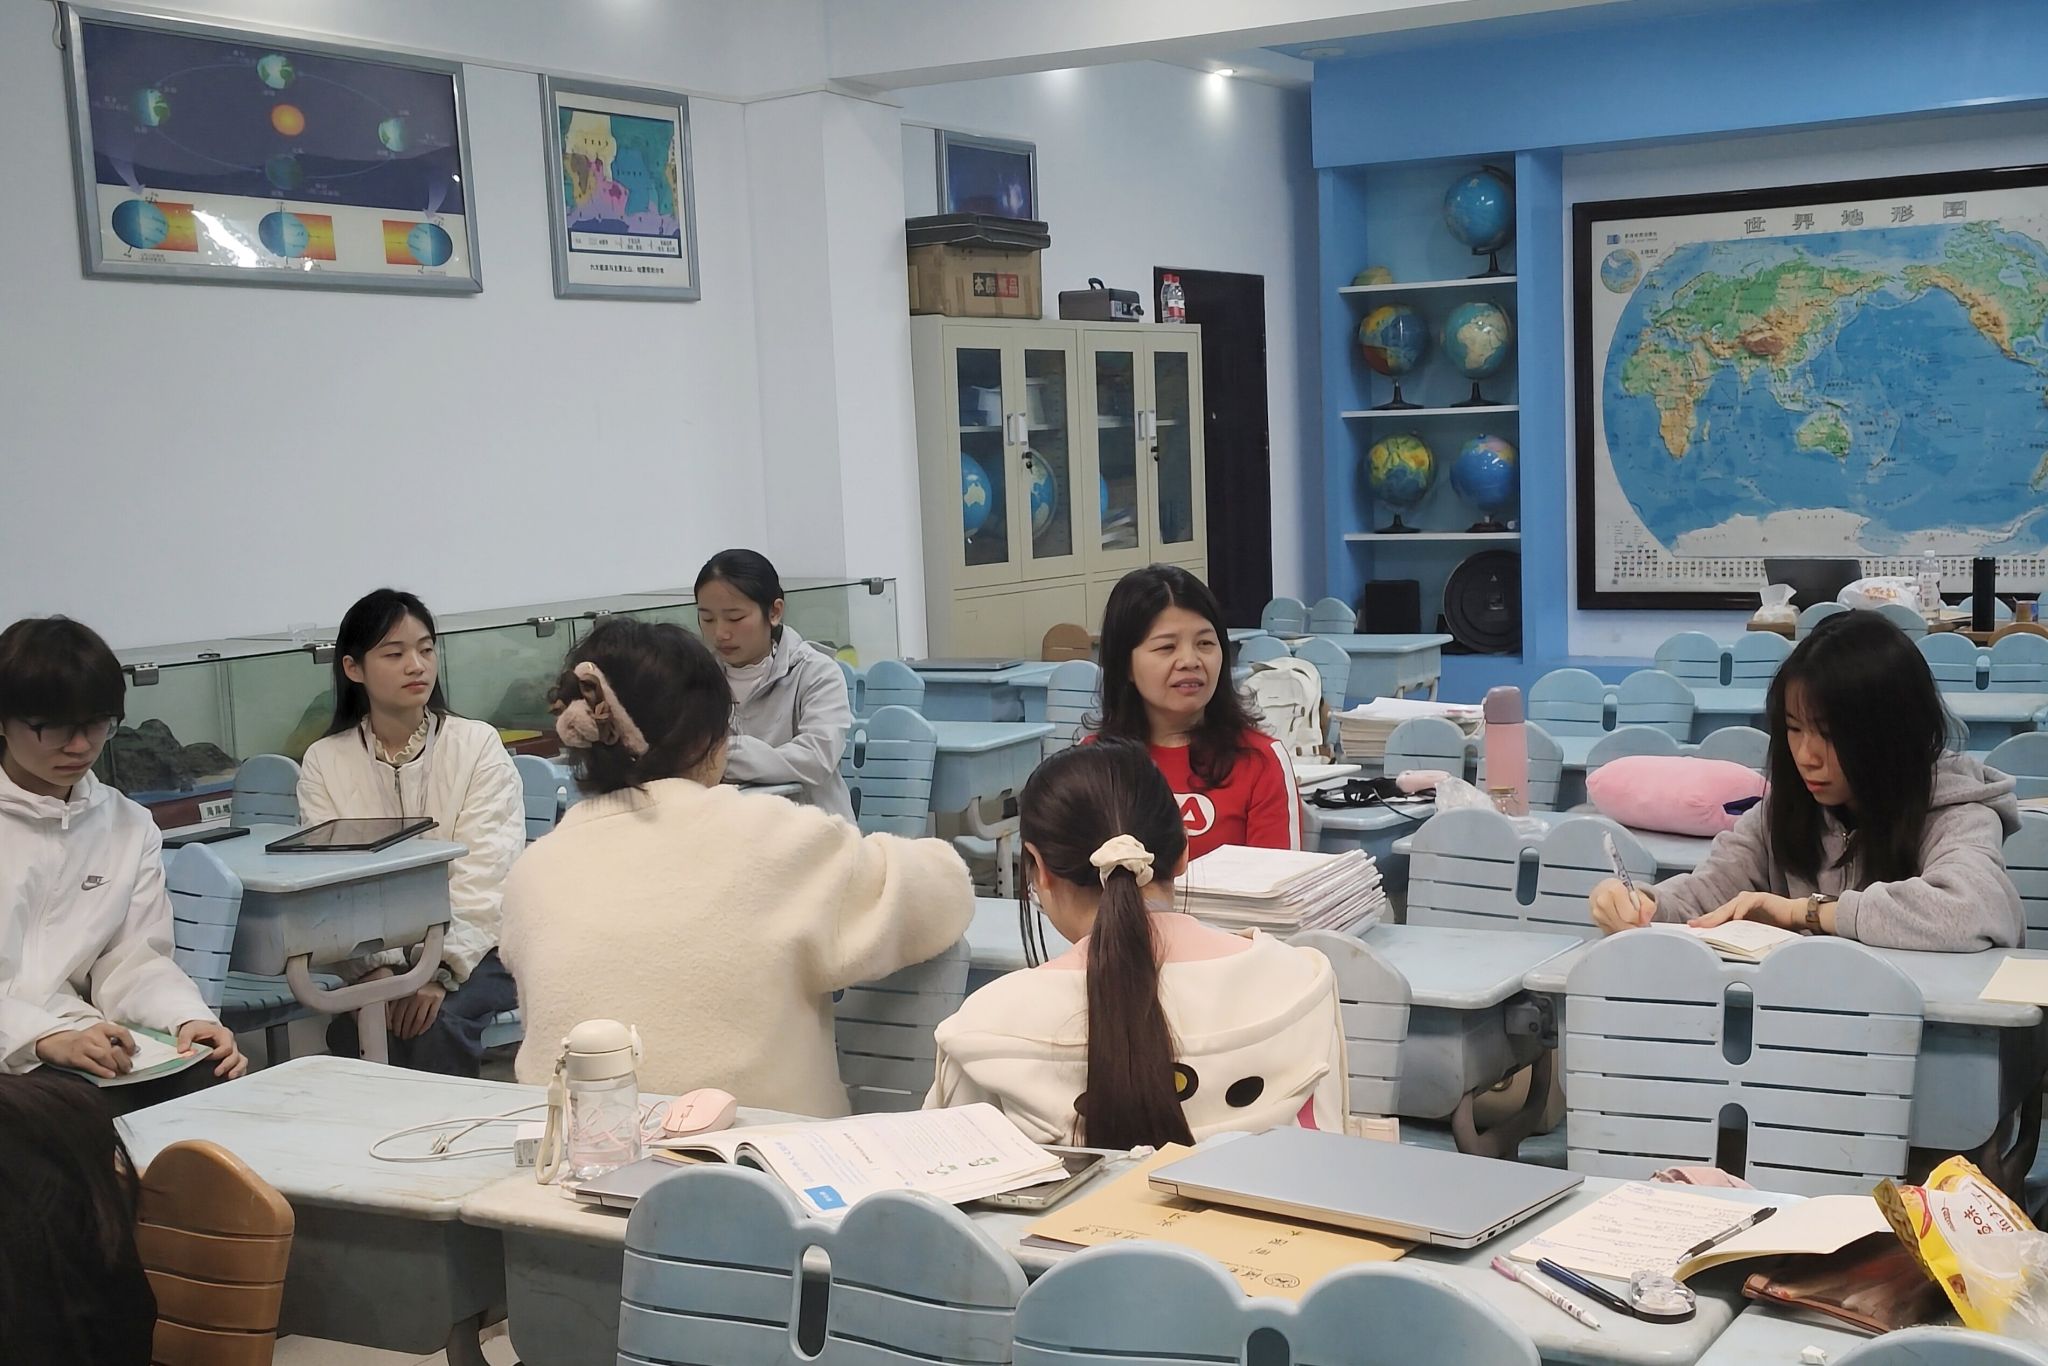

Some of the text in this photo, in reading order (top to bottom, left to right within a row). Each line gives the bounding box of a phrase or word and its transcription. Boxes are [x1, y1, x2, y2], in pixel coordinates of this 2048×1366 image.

[1744, 200, 1967, 234] 世界地形图
